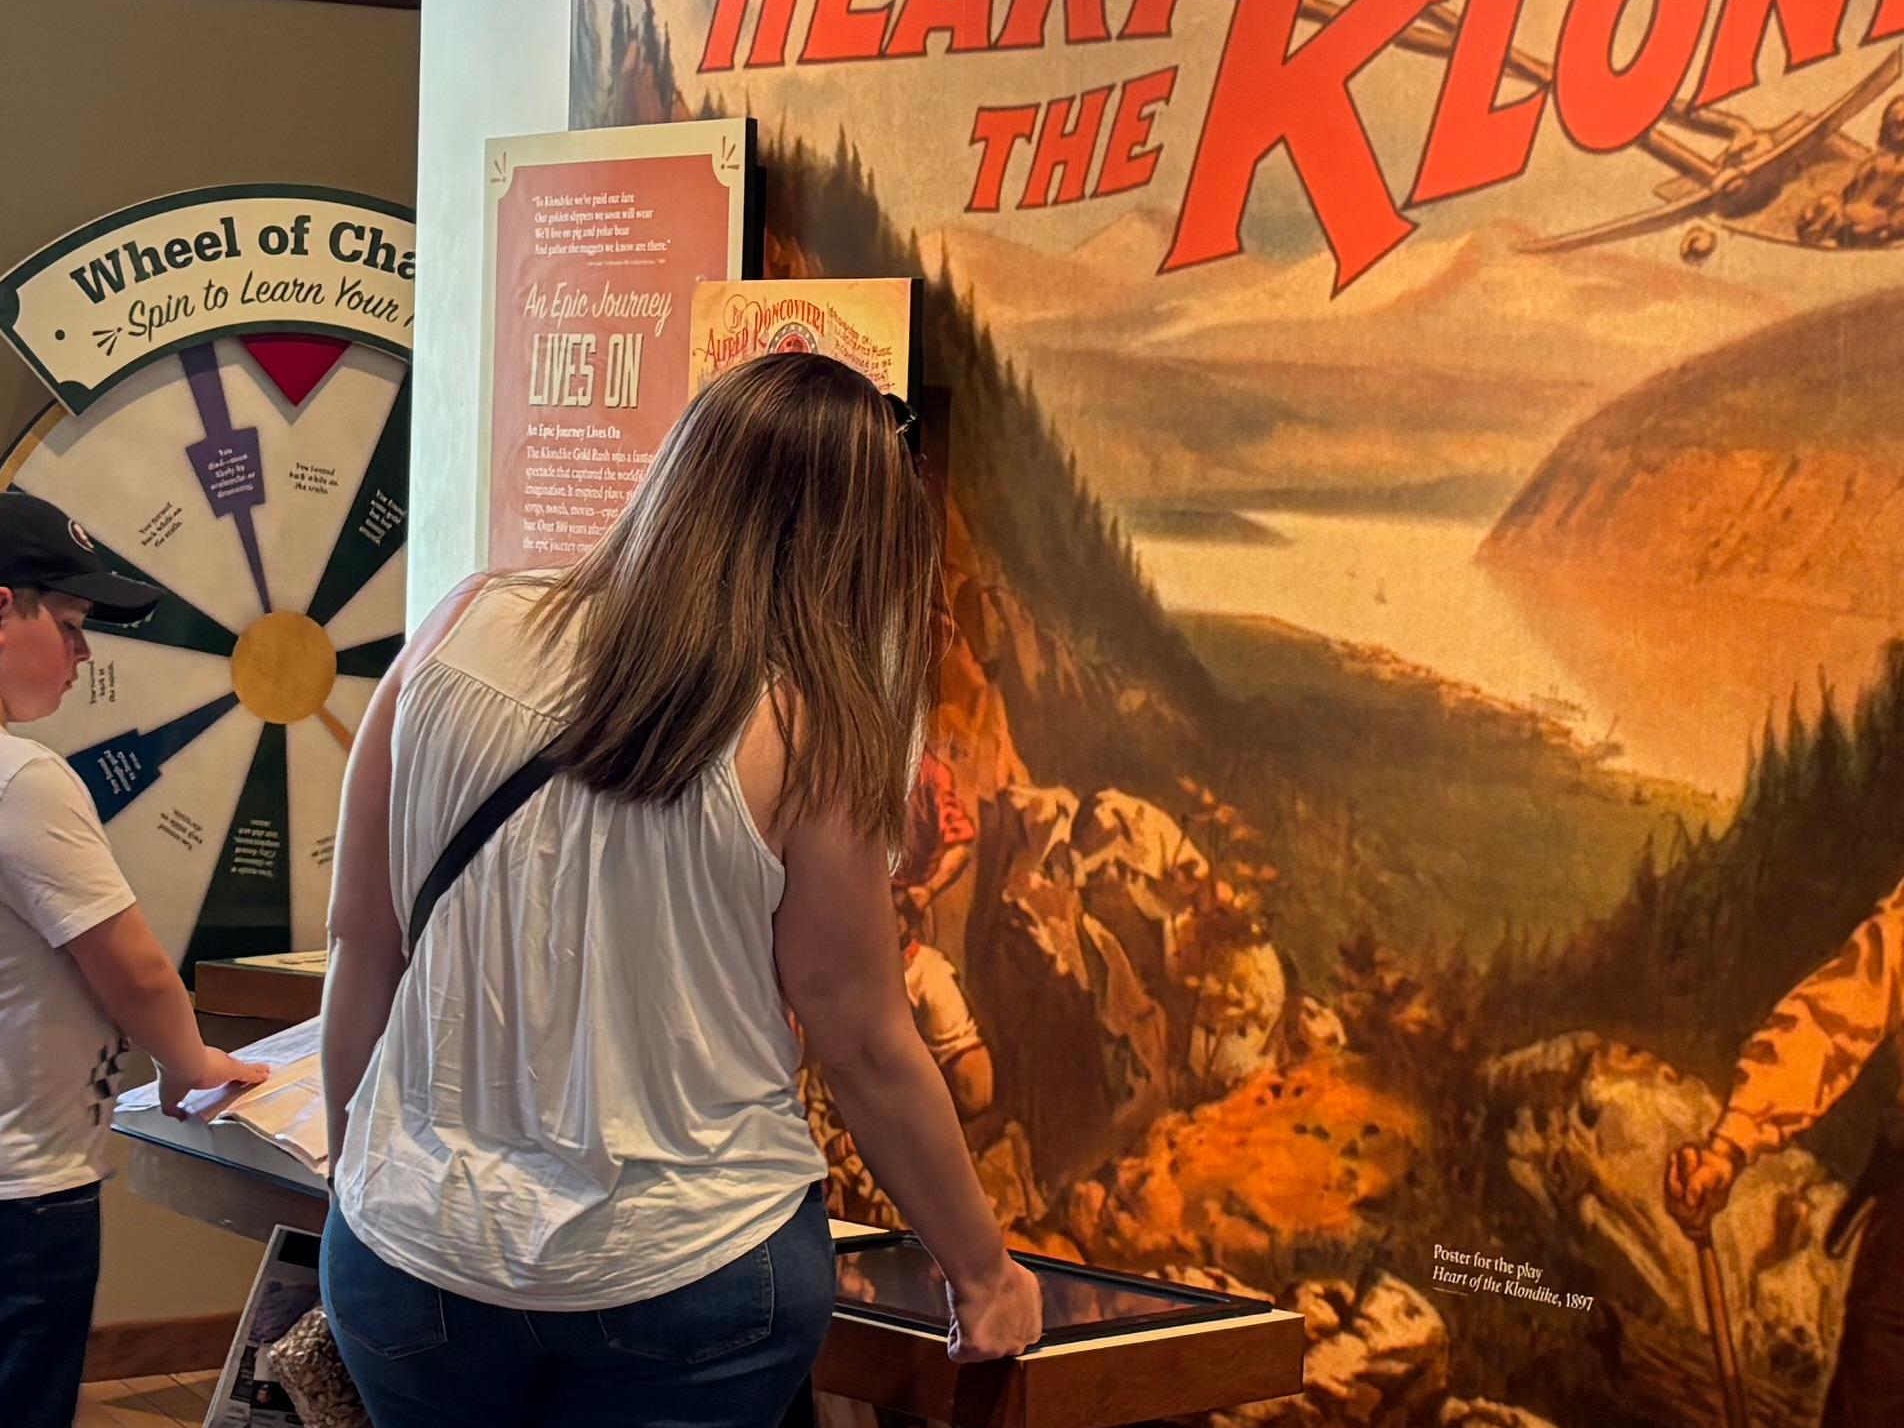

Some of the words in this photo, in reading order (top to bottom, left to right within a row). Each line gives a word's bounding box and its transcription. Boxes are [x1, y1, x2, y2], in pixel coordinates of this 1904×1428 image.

[964, 65, 1179, 214] THE
[70, 217, 241, 304] Wheel
[258, 215, 311, 256] of
[128, 294, 196, 344] Spin
[204, 278, 228, 310] to
[241, 270, 325, 306] Learn
[334, 275, 399, 320] Your
[523, 280, 547, 319] An
[550, 281, 589, 329] Epic
[592, 280, 673, 338] Journey
[528, 333, 597, 408] LIVES
[604, 333, 644, 409] ON
[538, 424, 555, 439] Epic
[555, 424, 585, 441] Journey
[587, 425, 607, 439] Lives
[608, 426, 621, 439] On
[573, 448, 590, 461] Gold
[1433, 1243, 1471, 1266] Poster
[1473, 1251, 1492, 1270] for
[1494, 1256, 1514, 1275] the
[1516, 1261, 1544, 1283] play
[1433, 1265, 1467, 1285] Heart
[1469, 1273, 1485, 1292] of
[1483, 1276, 1501, 1293] the
[1503, 1280, 1562, 1307] Klondike,
[1565, 1292, 1594, 1311] 1897
